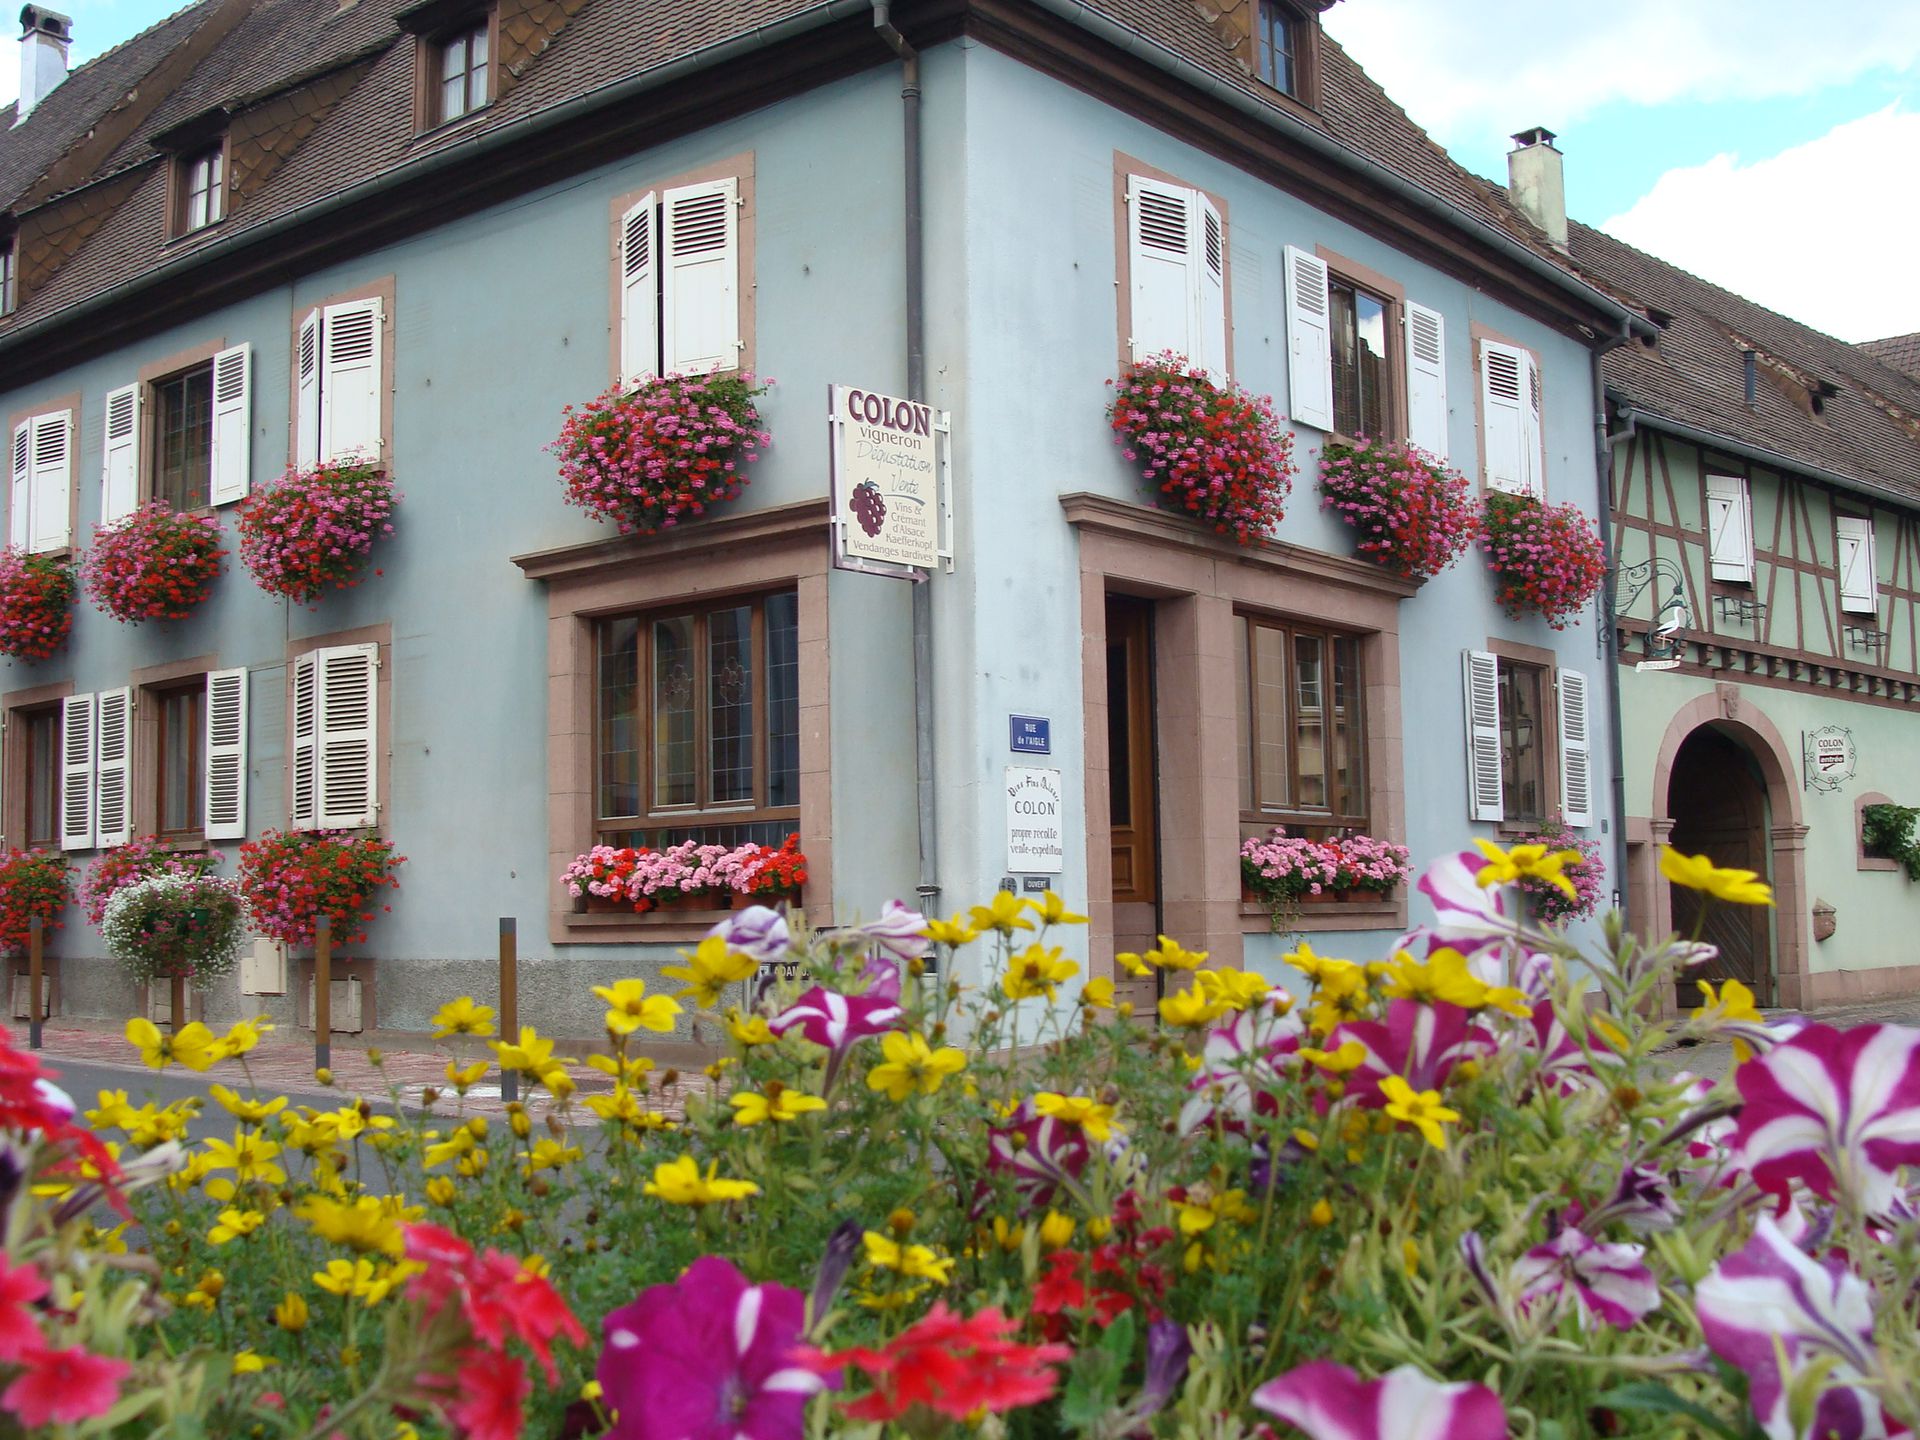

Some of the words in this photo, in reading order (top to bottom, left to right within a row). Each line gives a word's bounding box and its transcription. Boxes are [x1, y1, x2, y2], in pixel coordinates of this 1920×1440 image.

[848, 390, 931, 437] COLON
[860, 426, 921, 450] vigneron
[891, 468, 919, 494] Vente
[895, 501, 912, 514] Vins
[893, 524, 925, 538] d'Alsace
[886, 533, 932, 551] Kaefferkopf
[853, 540, 899, 557] Vendanges
[901, 549, 933, 562] tardives
[1025, 723, 1037, 733] RUE
[1017, 736, 1024, 745] de
[1818, 739, 1844, 747] COLON
[1014, 800, 1055, 815] COLON
[1011, 829, 1032, 842] propre
[1027, 880, 1047, 889] OUVERT
